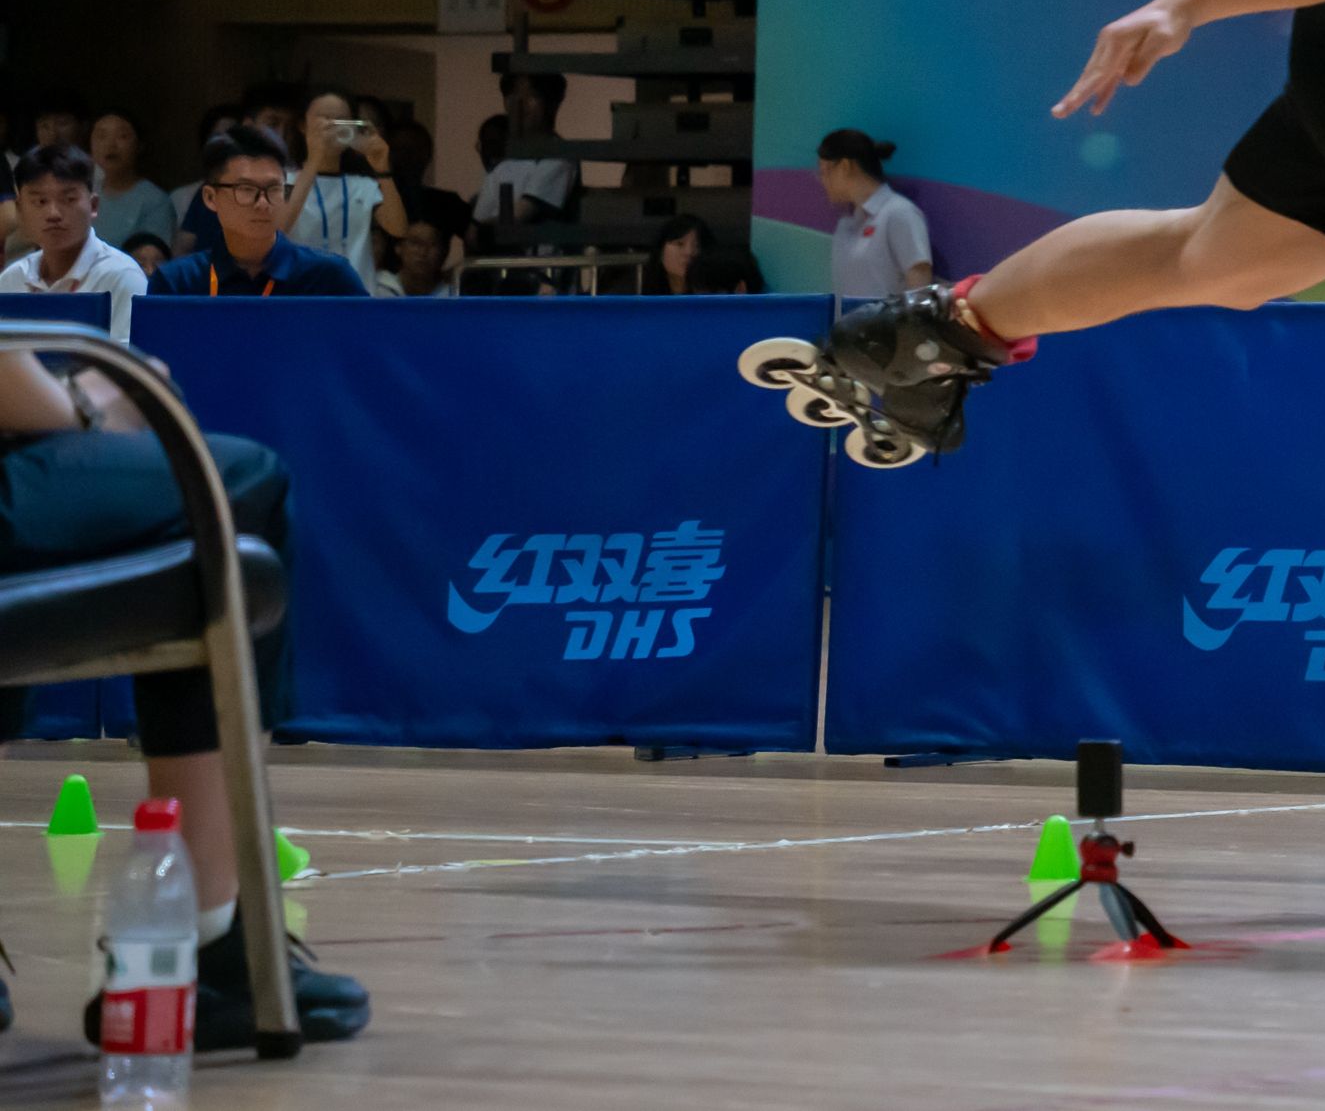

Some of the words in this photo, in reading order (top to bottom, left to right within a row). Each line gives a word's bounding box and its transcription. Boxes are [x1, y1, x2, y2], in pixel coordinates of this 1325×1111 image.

[447, 520, 727, 634] 红双喜
[563, 607, 712, 660] DHS
